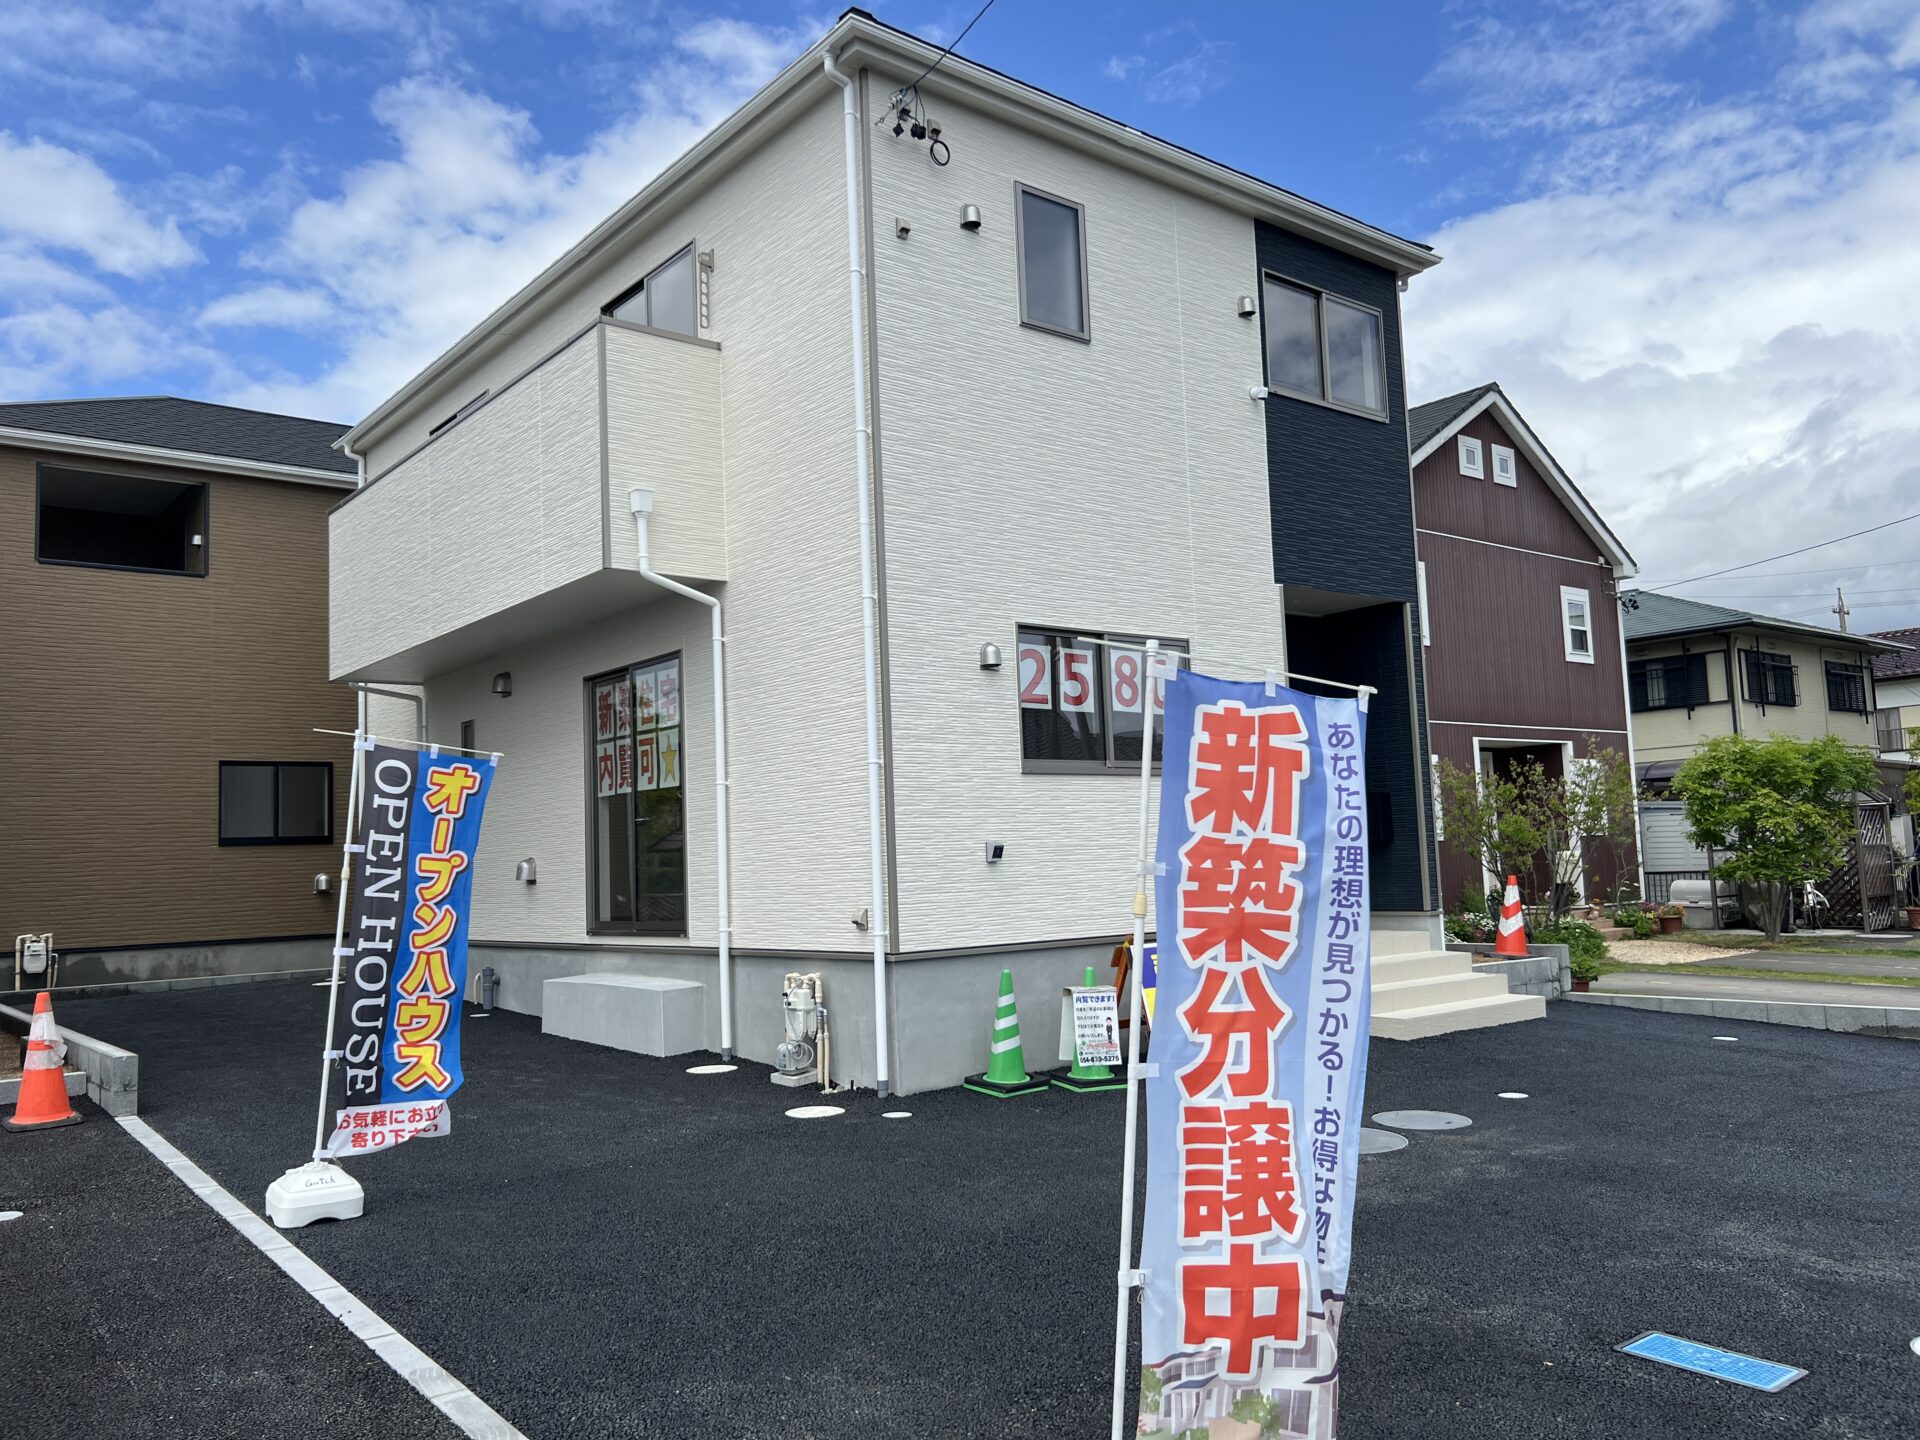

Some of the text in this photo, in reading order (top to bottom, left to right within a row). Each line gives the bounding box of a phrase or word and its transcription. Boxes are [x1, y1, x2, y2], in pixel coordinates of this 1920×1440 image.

[345, 758, 412, 1097] OPEN HOUSE
[394, 764, 479, 1091] オープンハウス
[1180, 706, 1304, 1375] 新築分譲中
